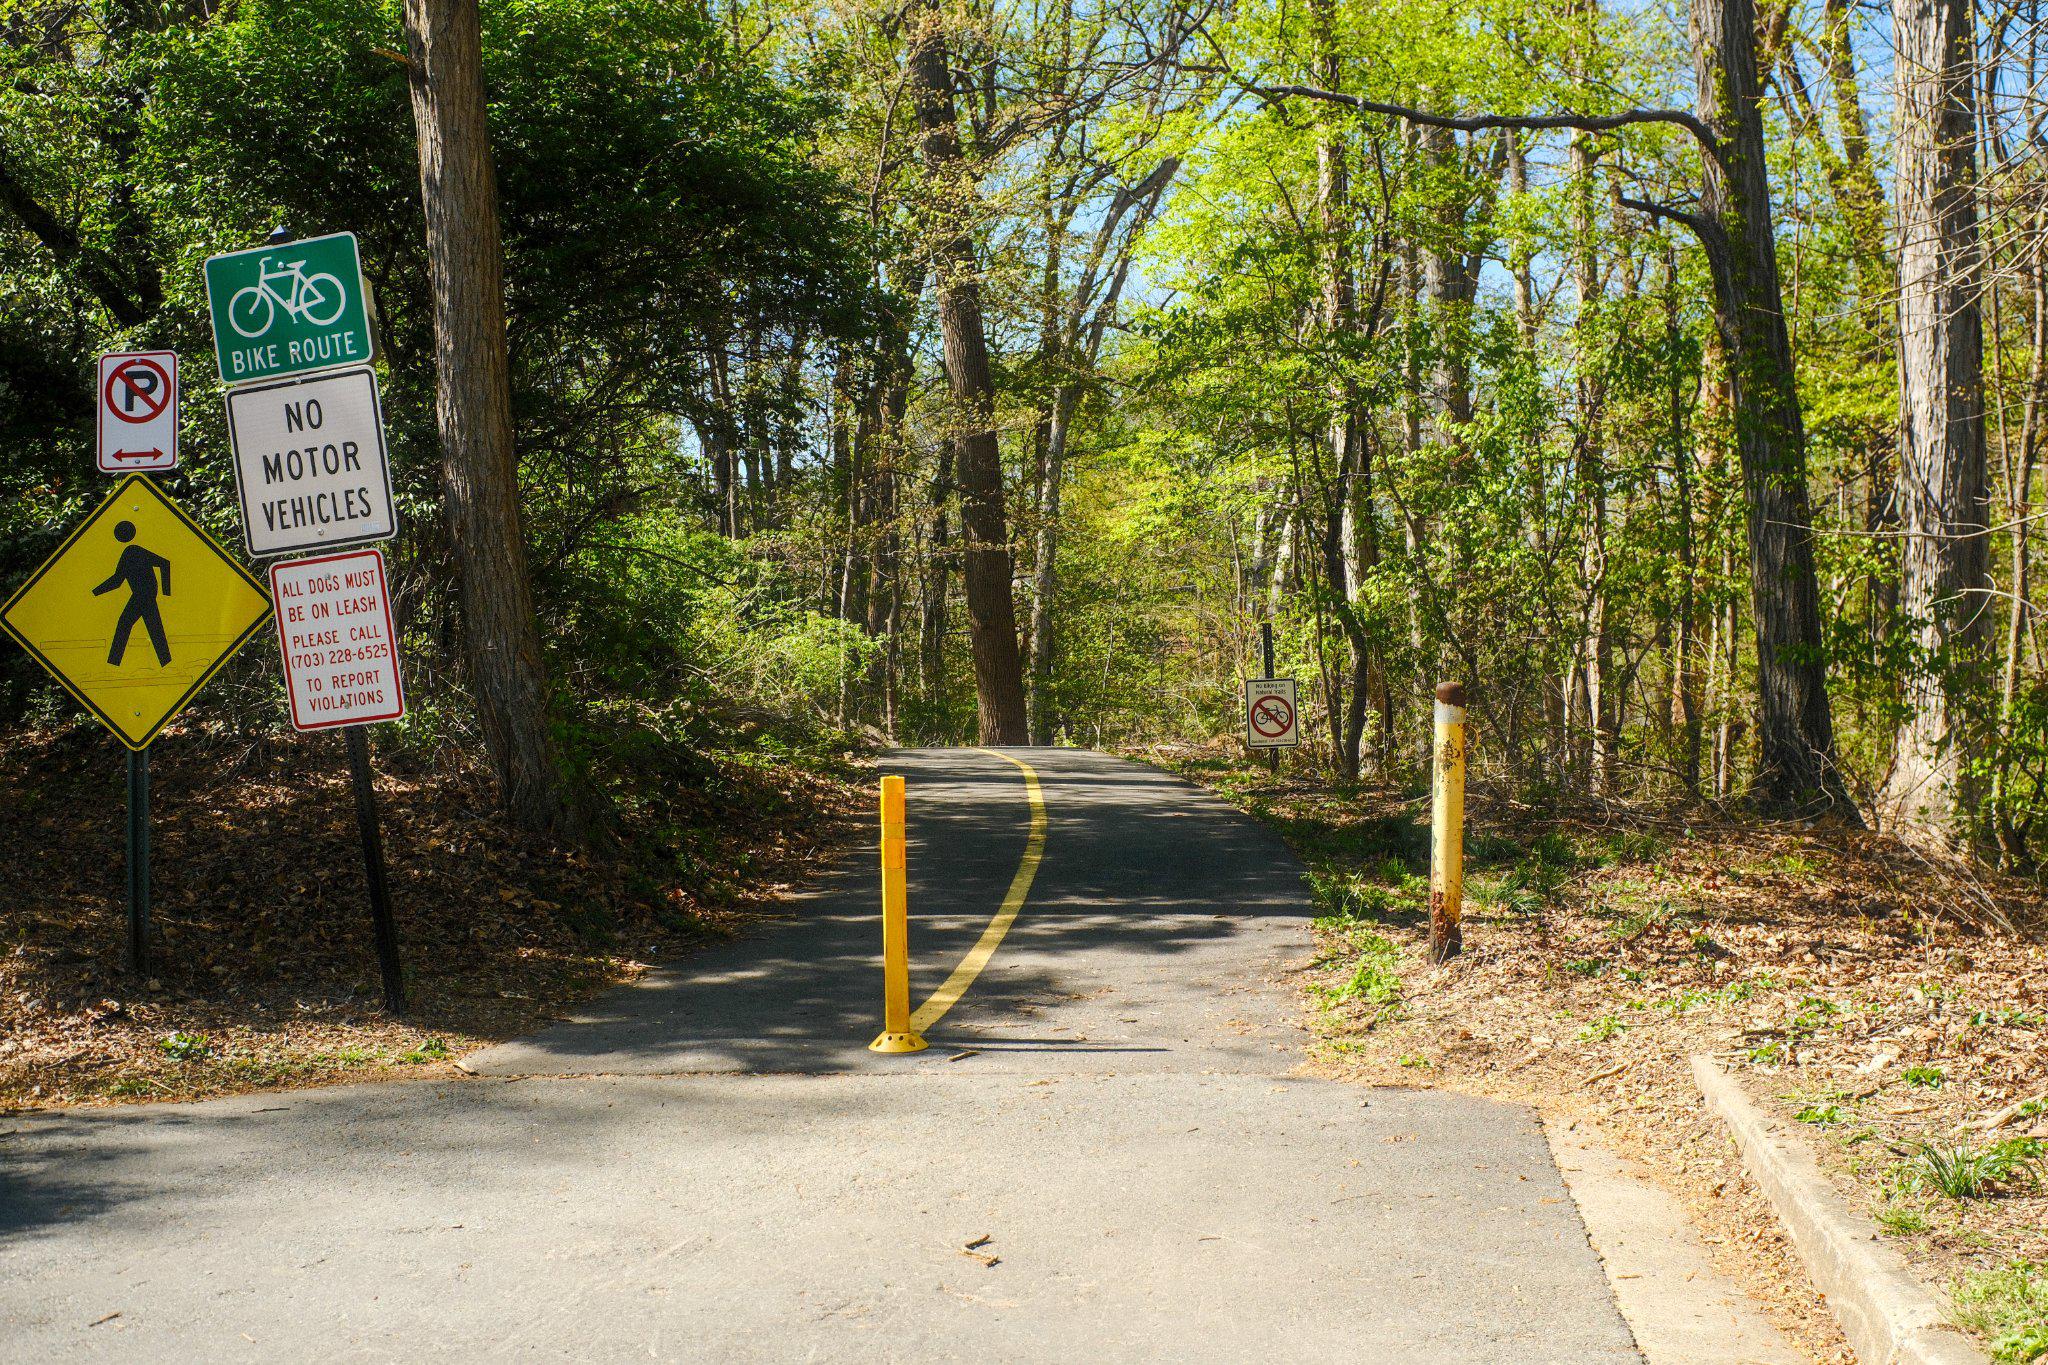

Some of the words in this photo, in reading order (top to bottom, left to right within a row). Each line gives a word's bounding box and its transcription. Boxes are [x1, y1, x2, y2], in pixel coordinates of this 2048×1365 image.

[231, 344, 280, 374] BIKE
[288, 331, 357, 365] ROUTE
[125, 371, 158, 411] P
[284, 399, 323, 433] NO
[262, 441, 361, 485] MOTOR
[261, 487, 372, 532] VEHICLES
[282, 581, 304, 599] ALL
[308, 575, 340, 595] DOGS
[344, 570, 376, 589] MUST
[288, 605, 306, 623] BE
[311, 602, 330, 619] ON
[336, 596, 377, 616] LEASH
[292, 630, 340, 650] PLEASE
[350, 624, 382, 642] CALL
[291, 654, 325, 670] (703)
[329, 643, 389, 665] 228-6525
[306, 677, 322, 693] TO
[332, 669, 380, 690] REPORT
[309, 689, 384, 712] VIOLATIONS
